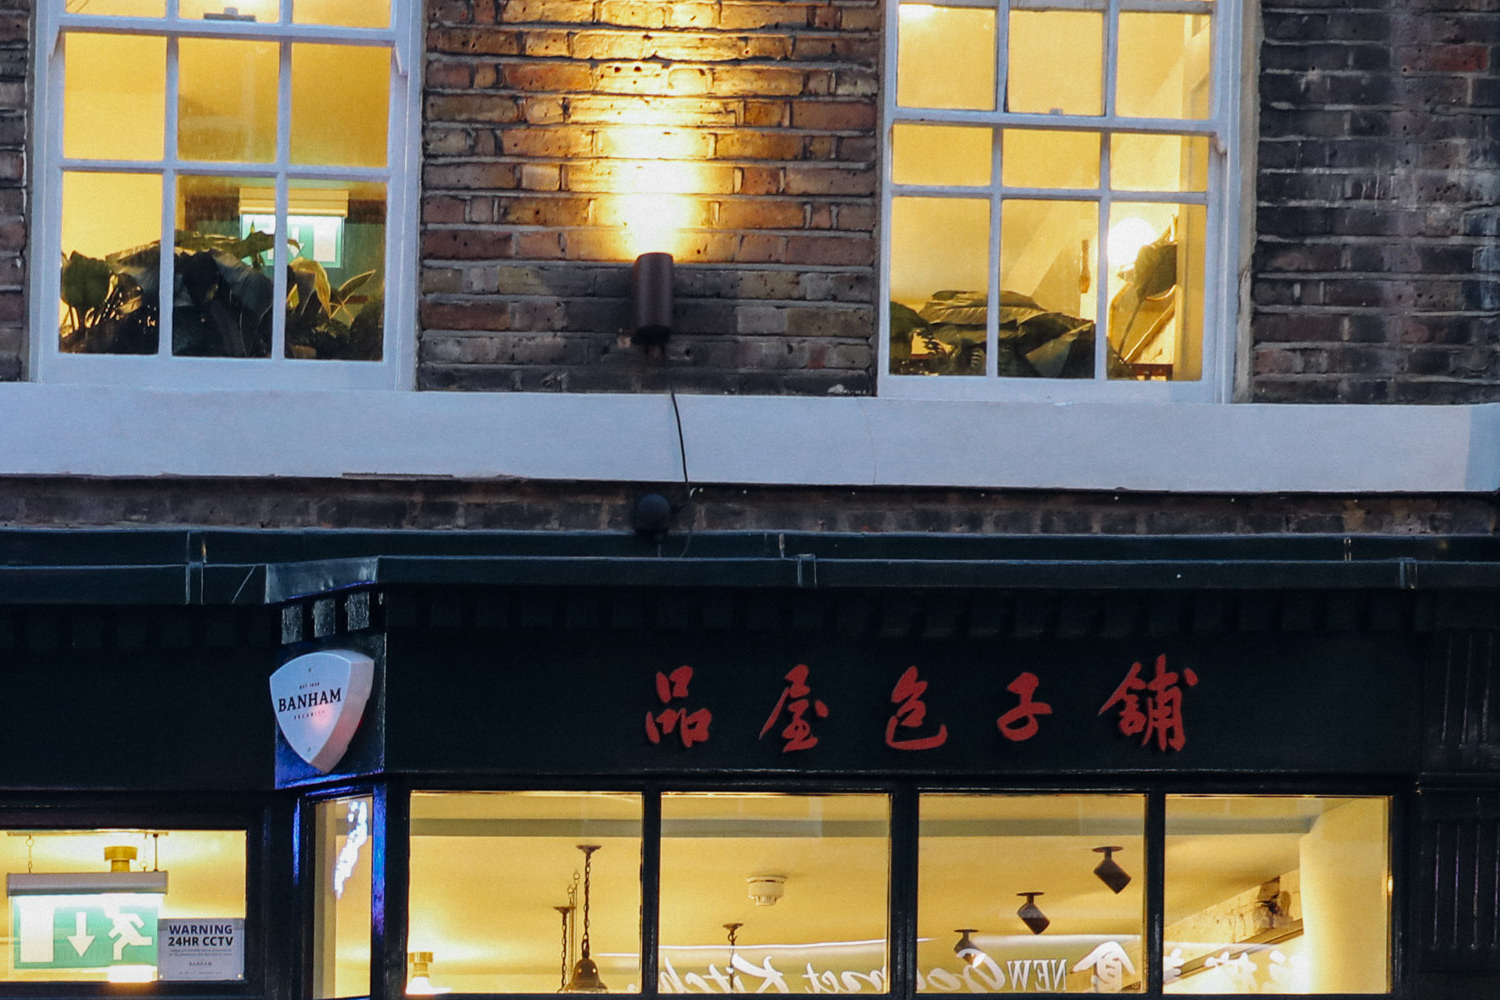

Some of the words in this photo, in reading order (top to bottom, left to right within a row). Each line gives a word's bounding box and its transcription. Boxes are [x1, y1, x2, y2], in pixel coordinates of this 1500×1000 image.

[278, 687, 342, 713] BANHAM
[169, 924, 233, 935] WARNING
[168, 936, 199, 947] 24HR
[202, 936, 233, 947] CCTV
